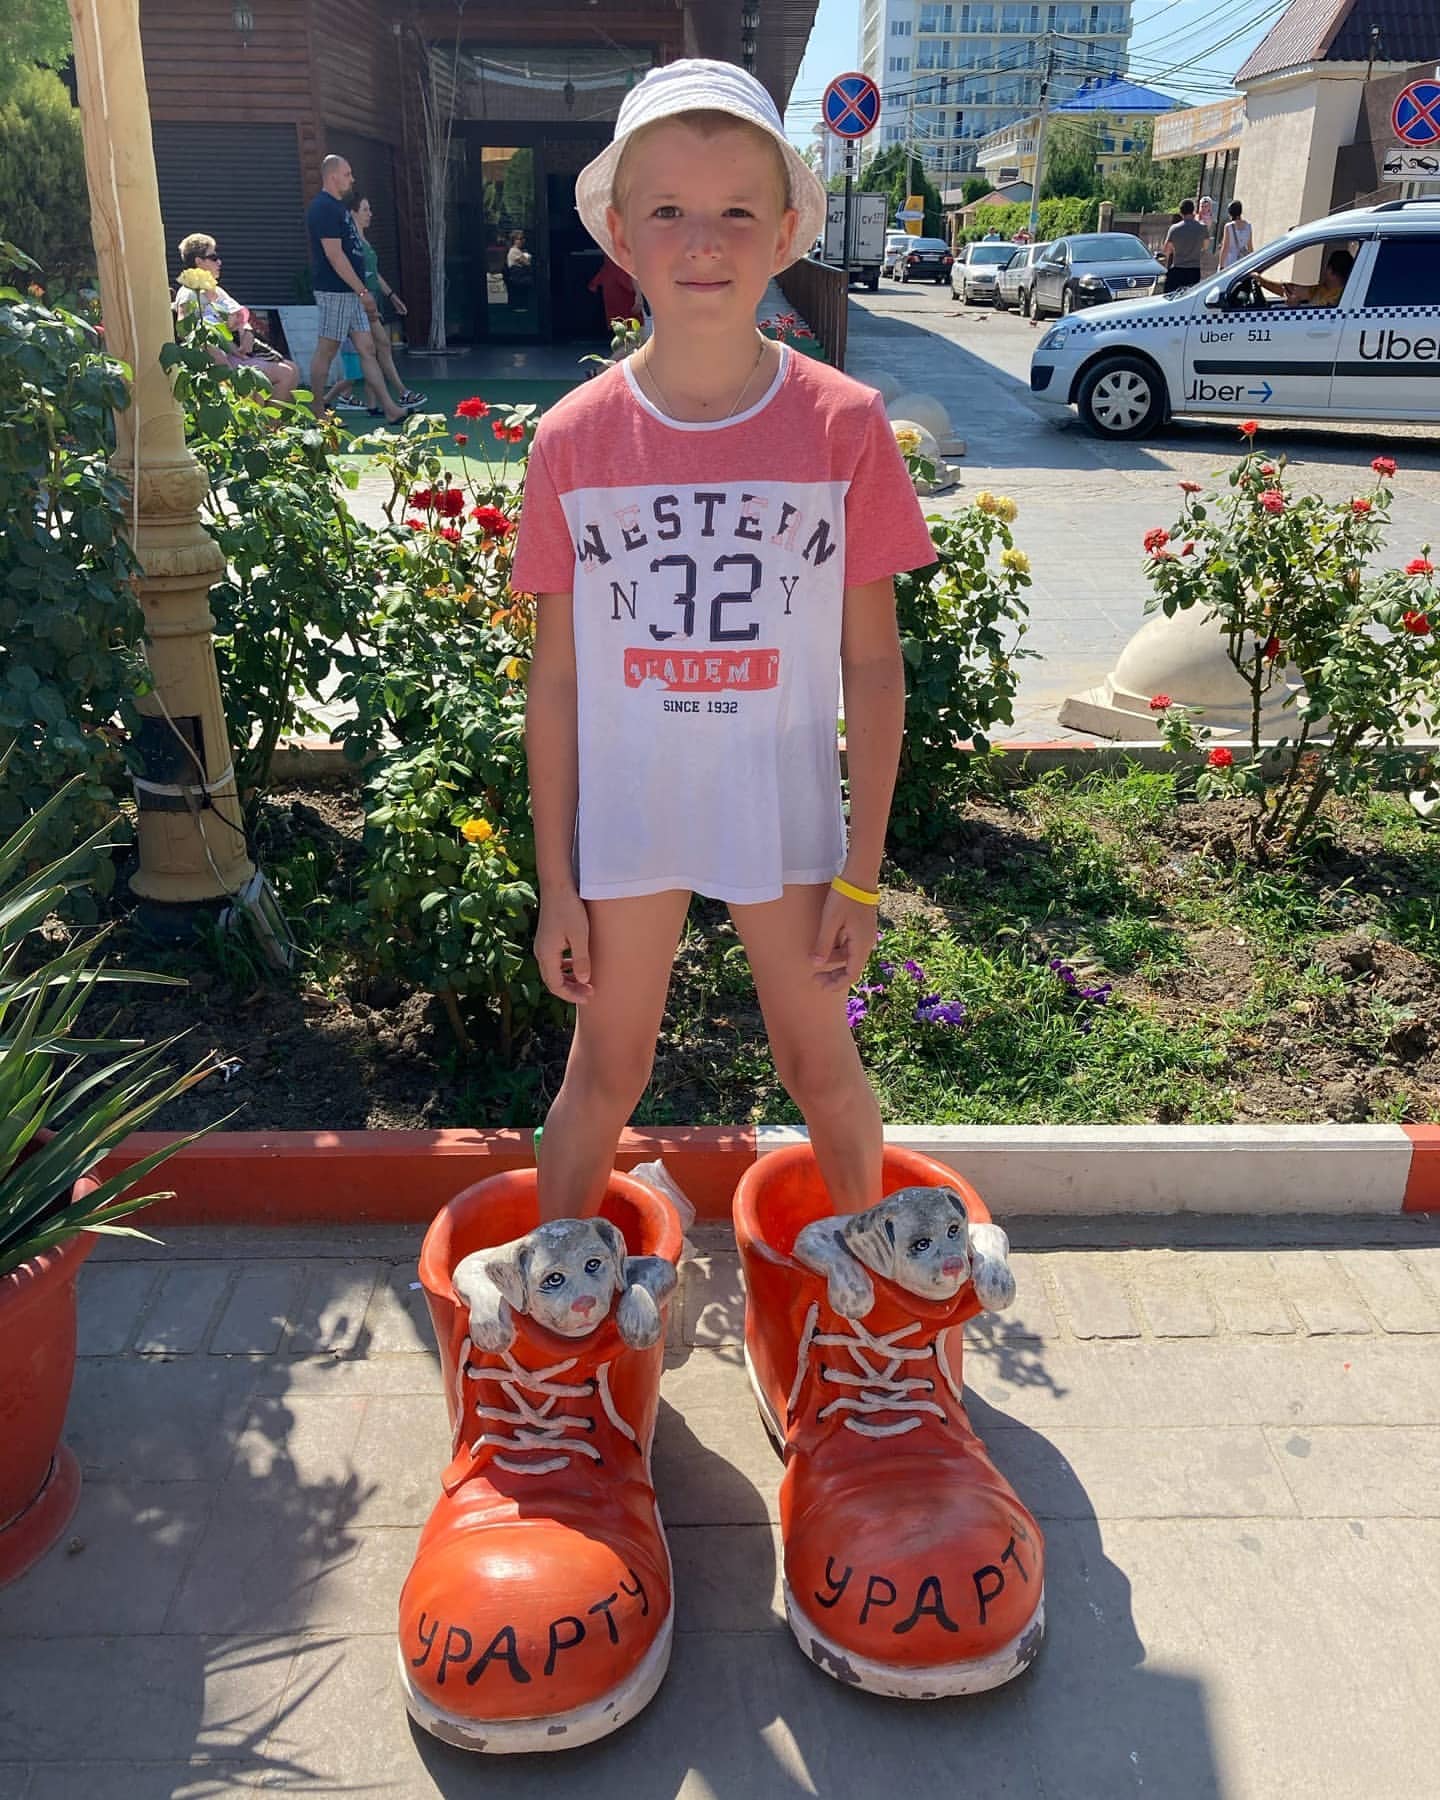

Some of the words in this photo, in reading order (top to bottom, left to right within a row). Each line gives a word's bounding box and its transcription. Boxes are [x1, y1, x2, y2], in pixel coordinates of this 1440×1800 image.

[1200, 330, 1235, 343] Uber
[1247, 329, 1272, 342] 511
[1358, 329, 1440, 361] Ube
[576, 491, 838, 575] WESTERN
[610, 580, 639, 620] N
[649, 553, 762, 642] 32
[779, 575, 800, 615] Y
[663, 700, 700, 713] SINCE
[707, 701, 738, 714] 1932
[411, 1568, 651, 1686] УРАРТУ
